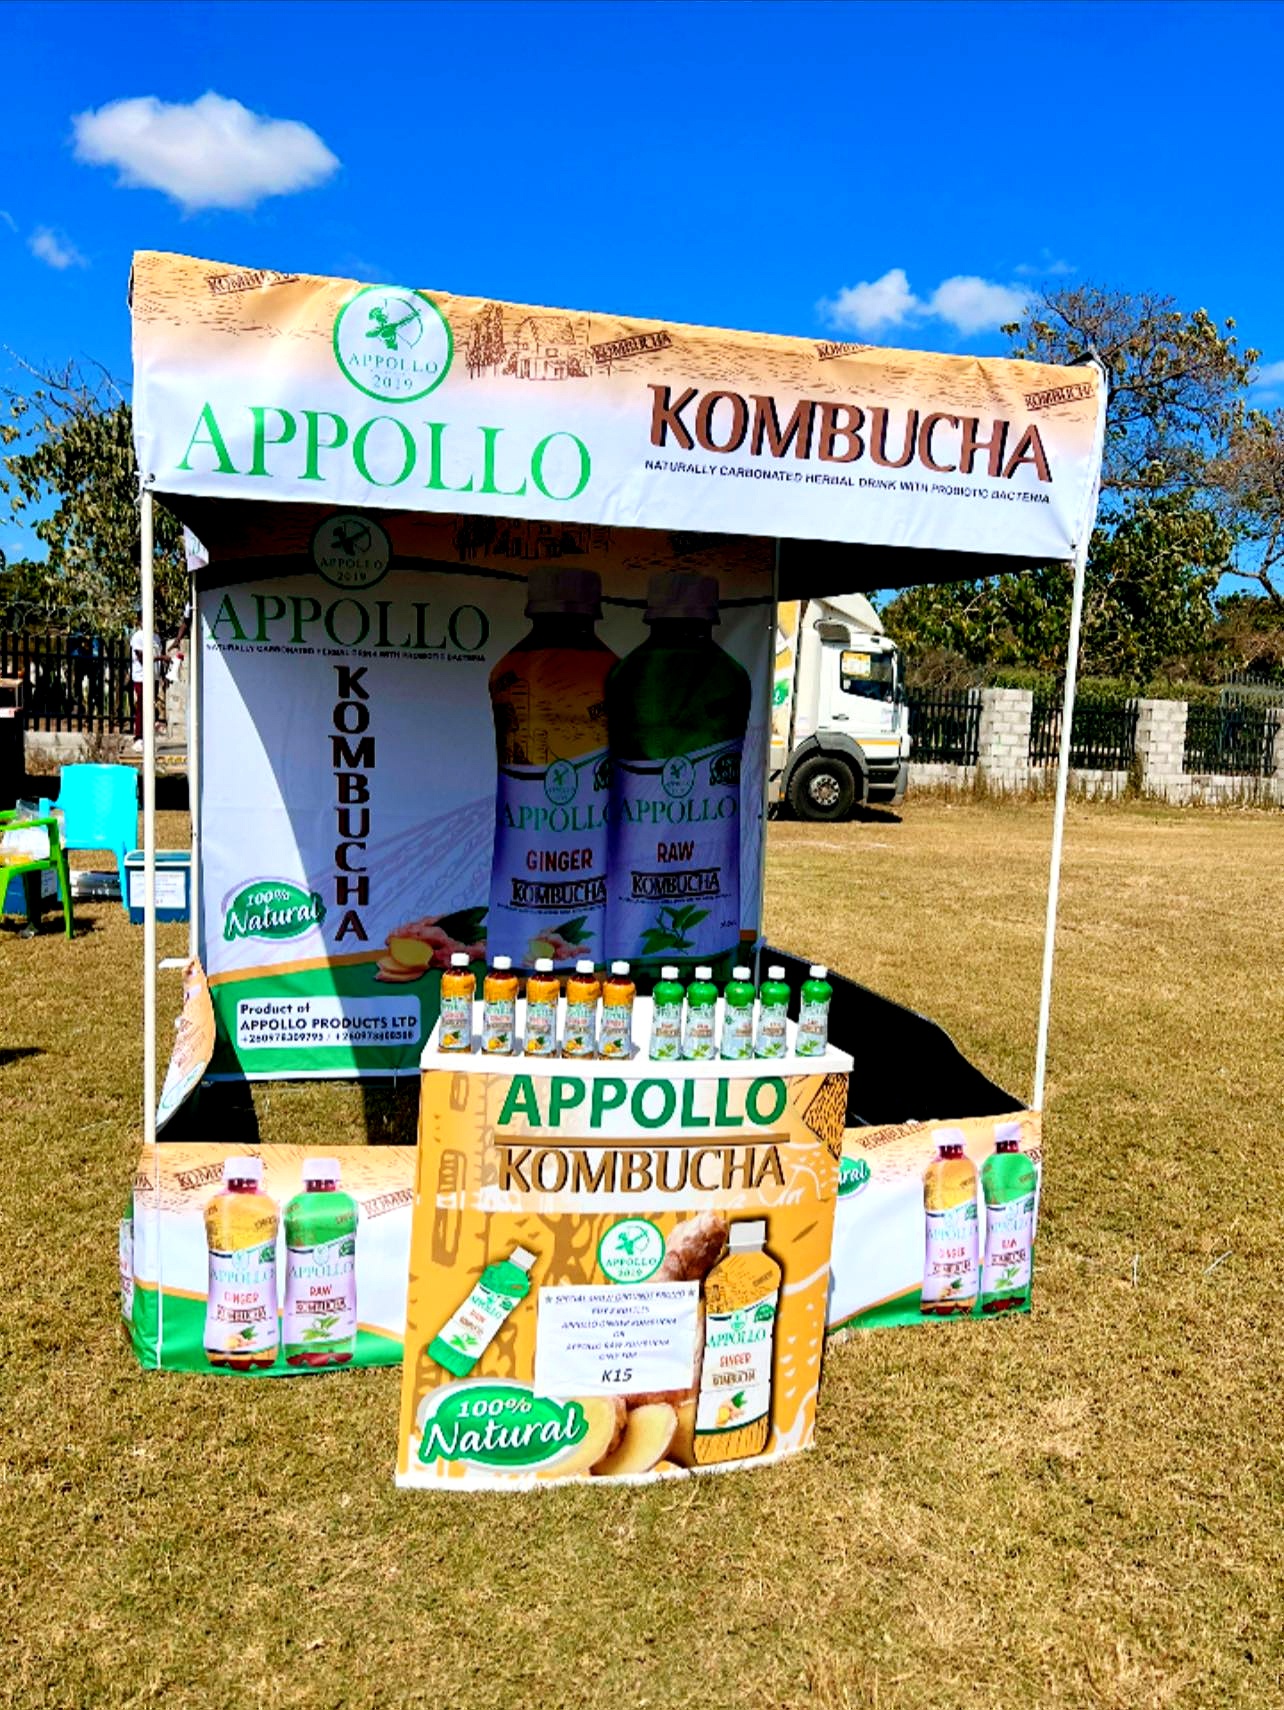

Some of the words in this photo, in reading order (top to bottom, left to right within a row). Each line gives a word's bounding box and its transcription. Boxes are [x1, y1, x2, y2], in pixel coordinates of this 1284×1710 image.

[349, 353, 437, 374] APPOLLO
[374, 374, 413, 390] 2019
[648, 383, 1053, 483] KOMBUCHA
[176, 400, 591, 500] APPOLLO
[645, 460, 717, 476] NATURALLY
[720, 465, 803, 482] CARBONATED
[805, 474, 854, 487] HERBAL
[859, 477, 896, 490] DRINK
[900, 482, 928, 493] WITH
[931, 483, 988, 499] PROBIOTIC
[991, 490, 1050, 504] BACTERIA
[320, 558, 382, 570] APPOLLO
[208, 593, 490, 650] APPOLLO
[328, 665, 375, 941] KOMBUCHA
[620, 795, 737, 824] APPOLLO
[527, 849, 592, 872] GINGER
[657, 841, 694, 863] RAW
[513, 879, 607, 904] KOMBUCHA
[633, 872, 720, 897] KOMBUCHA
[247, 889, 289, 907] 100%
[228, 896, 319, 937] Natural
[240, 1003, 293, 1015] Product
[297, 1002, 310, 1014] of
[240, 1018, 307, 1031] APPOLLO
[312, 1017, 387, 1029] PRODUCTS
[392, 1016, 417, 1028] LTD
[498, 1074, 787, 1129] APPOLLO
[500, 1146, 785, 1194] KOMBUCHA
[606, 1257, 657, 1267] APPOLLO
[309, 1284, 333, 1297] RAW
[601, 1368, 633, 1383] K15
[458, 1398, 532, 1418] 100%
[425, 1406, 582, 1457] Natural
